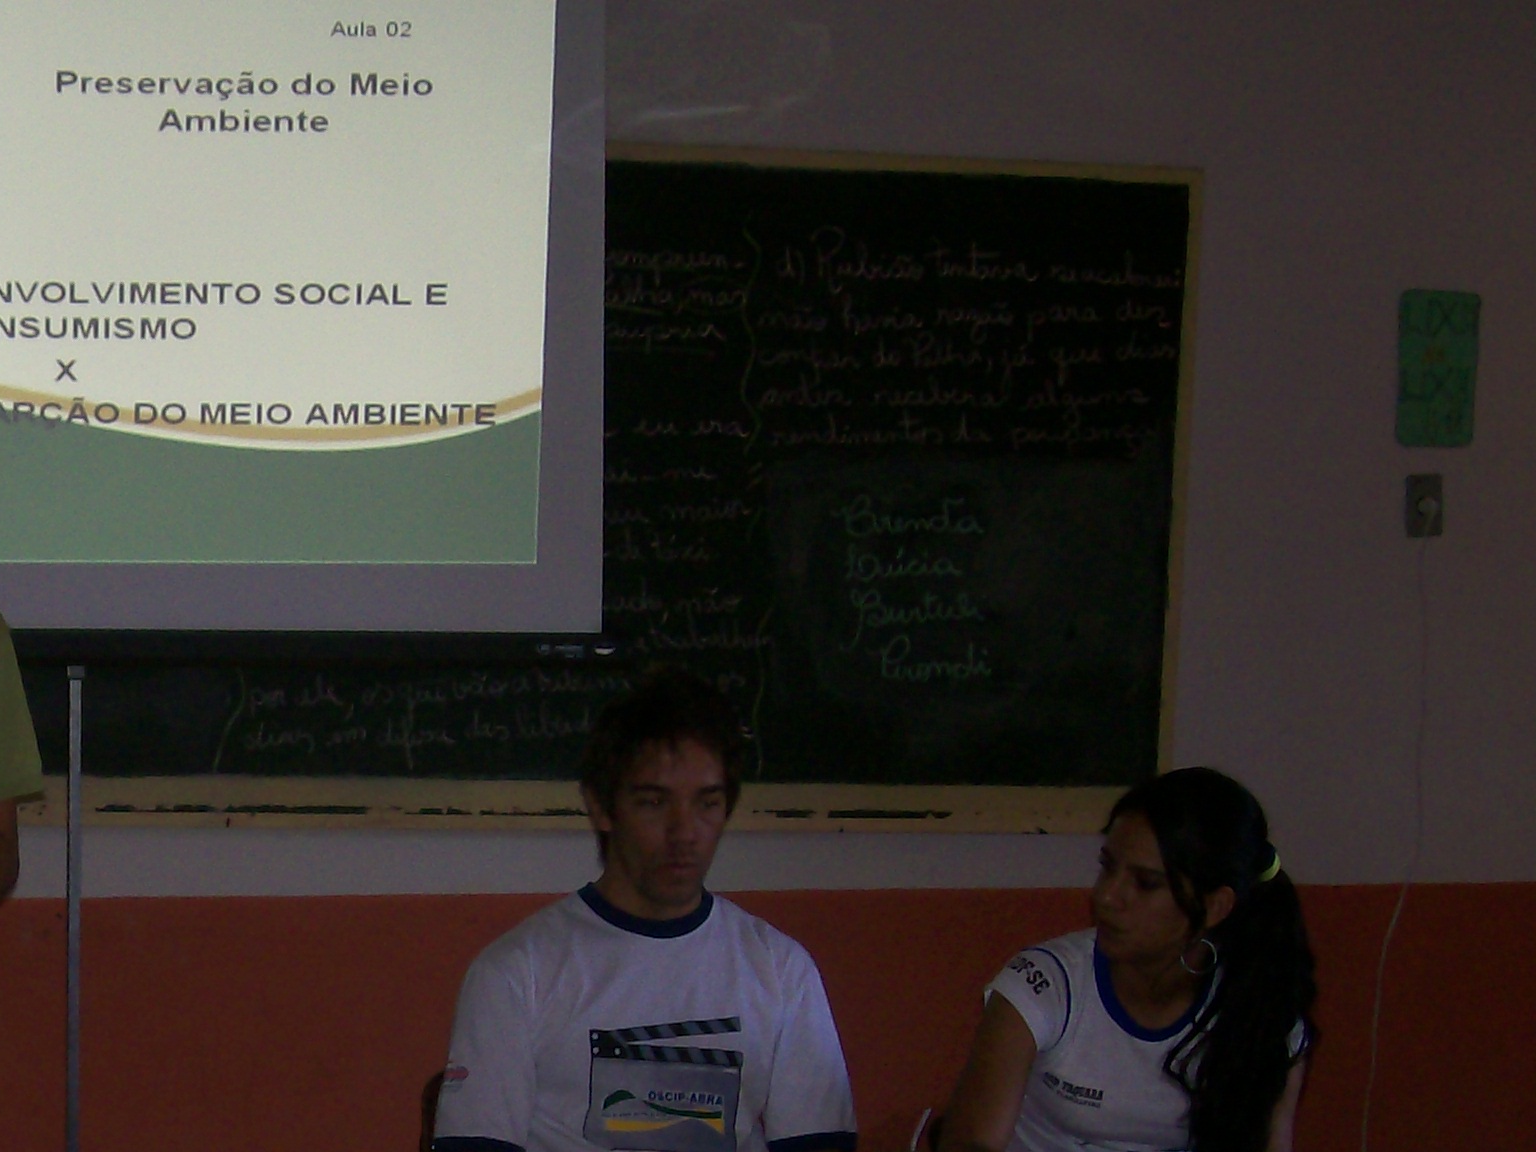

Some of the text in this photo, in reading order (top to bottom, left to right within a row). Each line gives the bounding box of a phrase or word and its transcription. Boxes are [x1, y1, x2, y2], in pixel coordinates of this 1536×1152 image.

[330, 21, 412, 38] Aula 02
[56, 70, 433, 101] Preservação do Meio
[159, 109, 329, 133] Ambiente
[274, 283, 412, 306] SOCIAL
[426, 283, 448, 306] E
[133, 402, 187, 426] DO
[199, 403, 292, 427] MEIO
[306, 402, 496, 427] AMBIENTE
